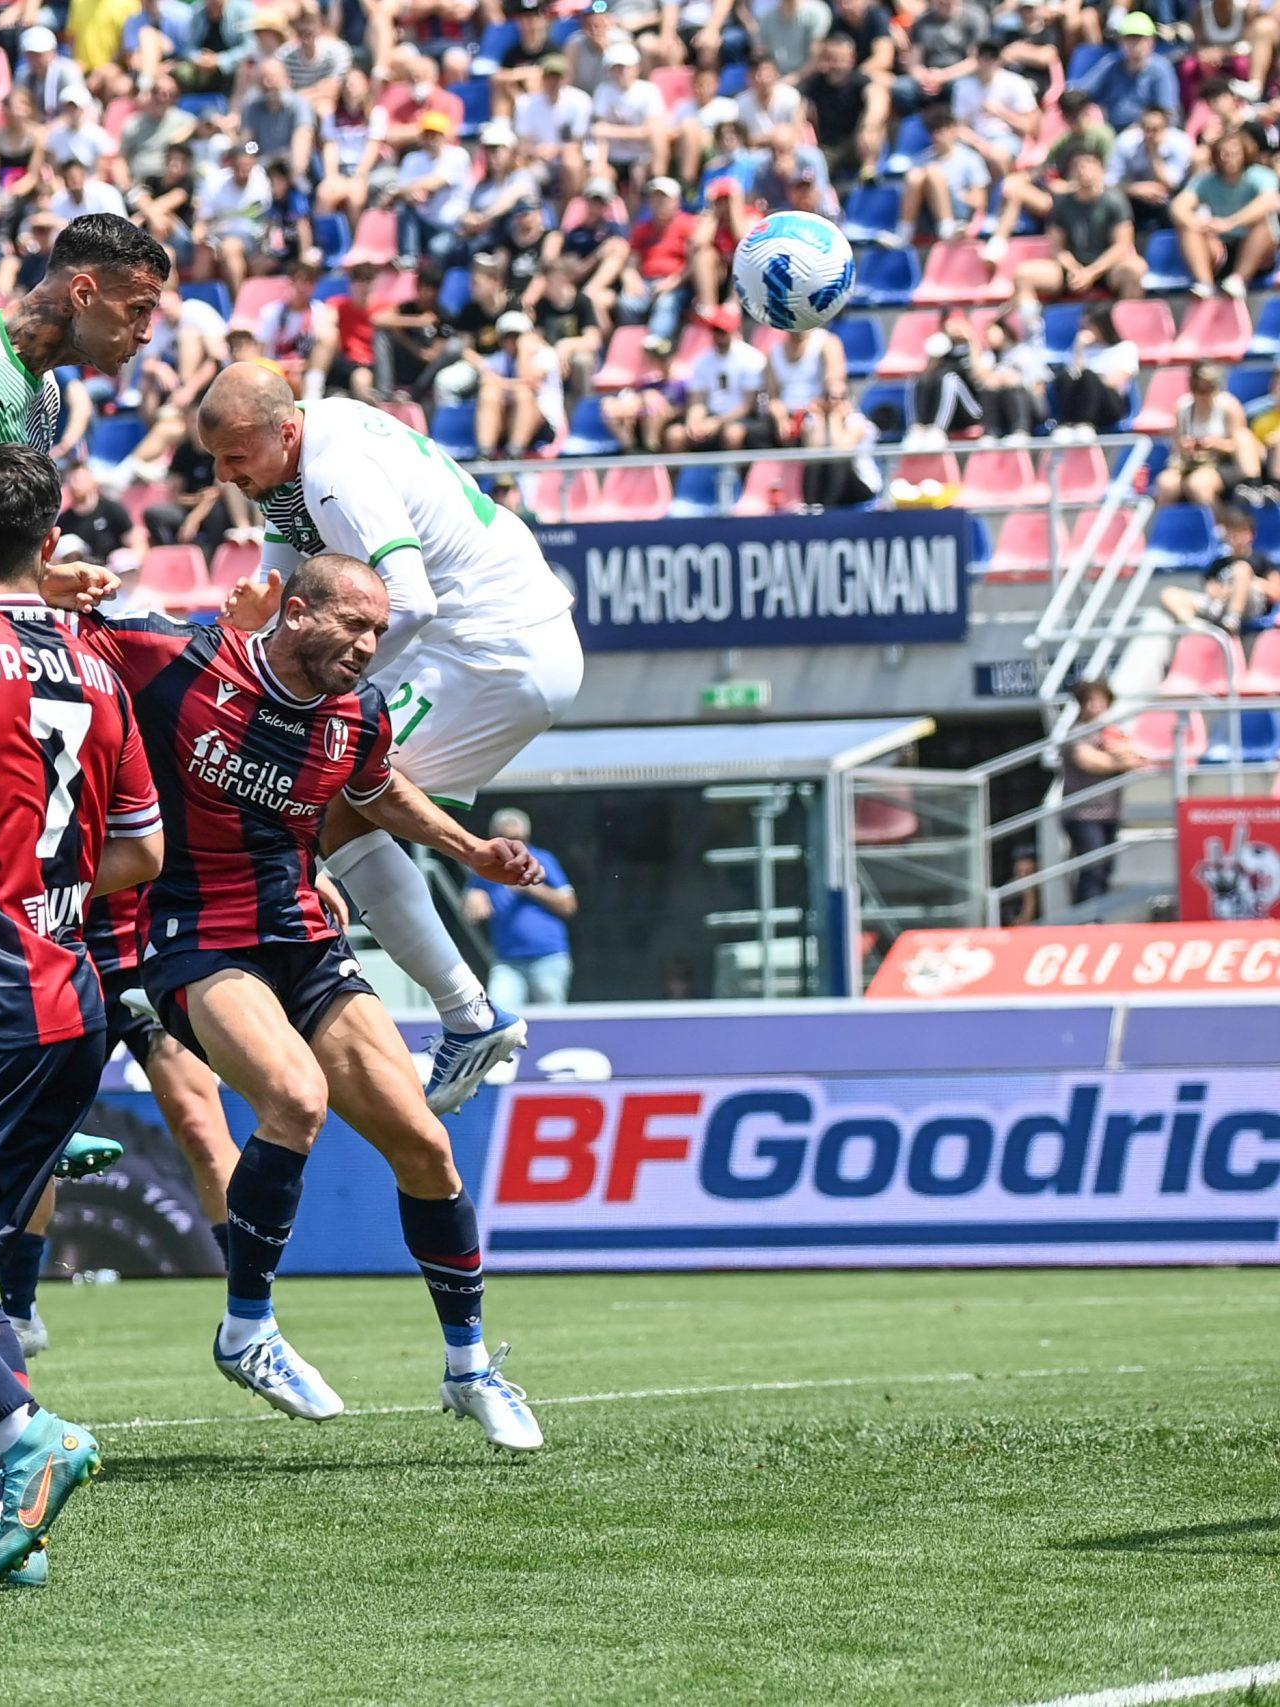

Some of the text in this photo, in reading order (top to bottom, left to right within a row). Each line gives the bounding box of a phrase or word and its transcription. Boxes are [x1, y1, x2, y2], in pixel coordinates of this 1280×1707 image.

[585, 535, 958, 625] MARCO PAVIGNANI
[257, 708, 307, 738] Selenella
[30, 697, 93, 859] 7
[1024, 943, 1123, 986] GLI
[495, 1083, 1280, 1204] BFGoodric
